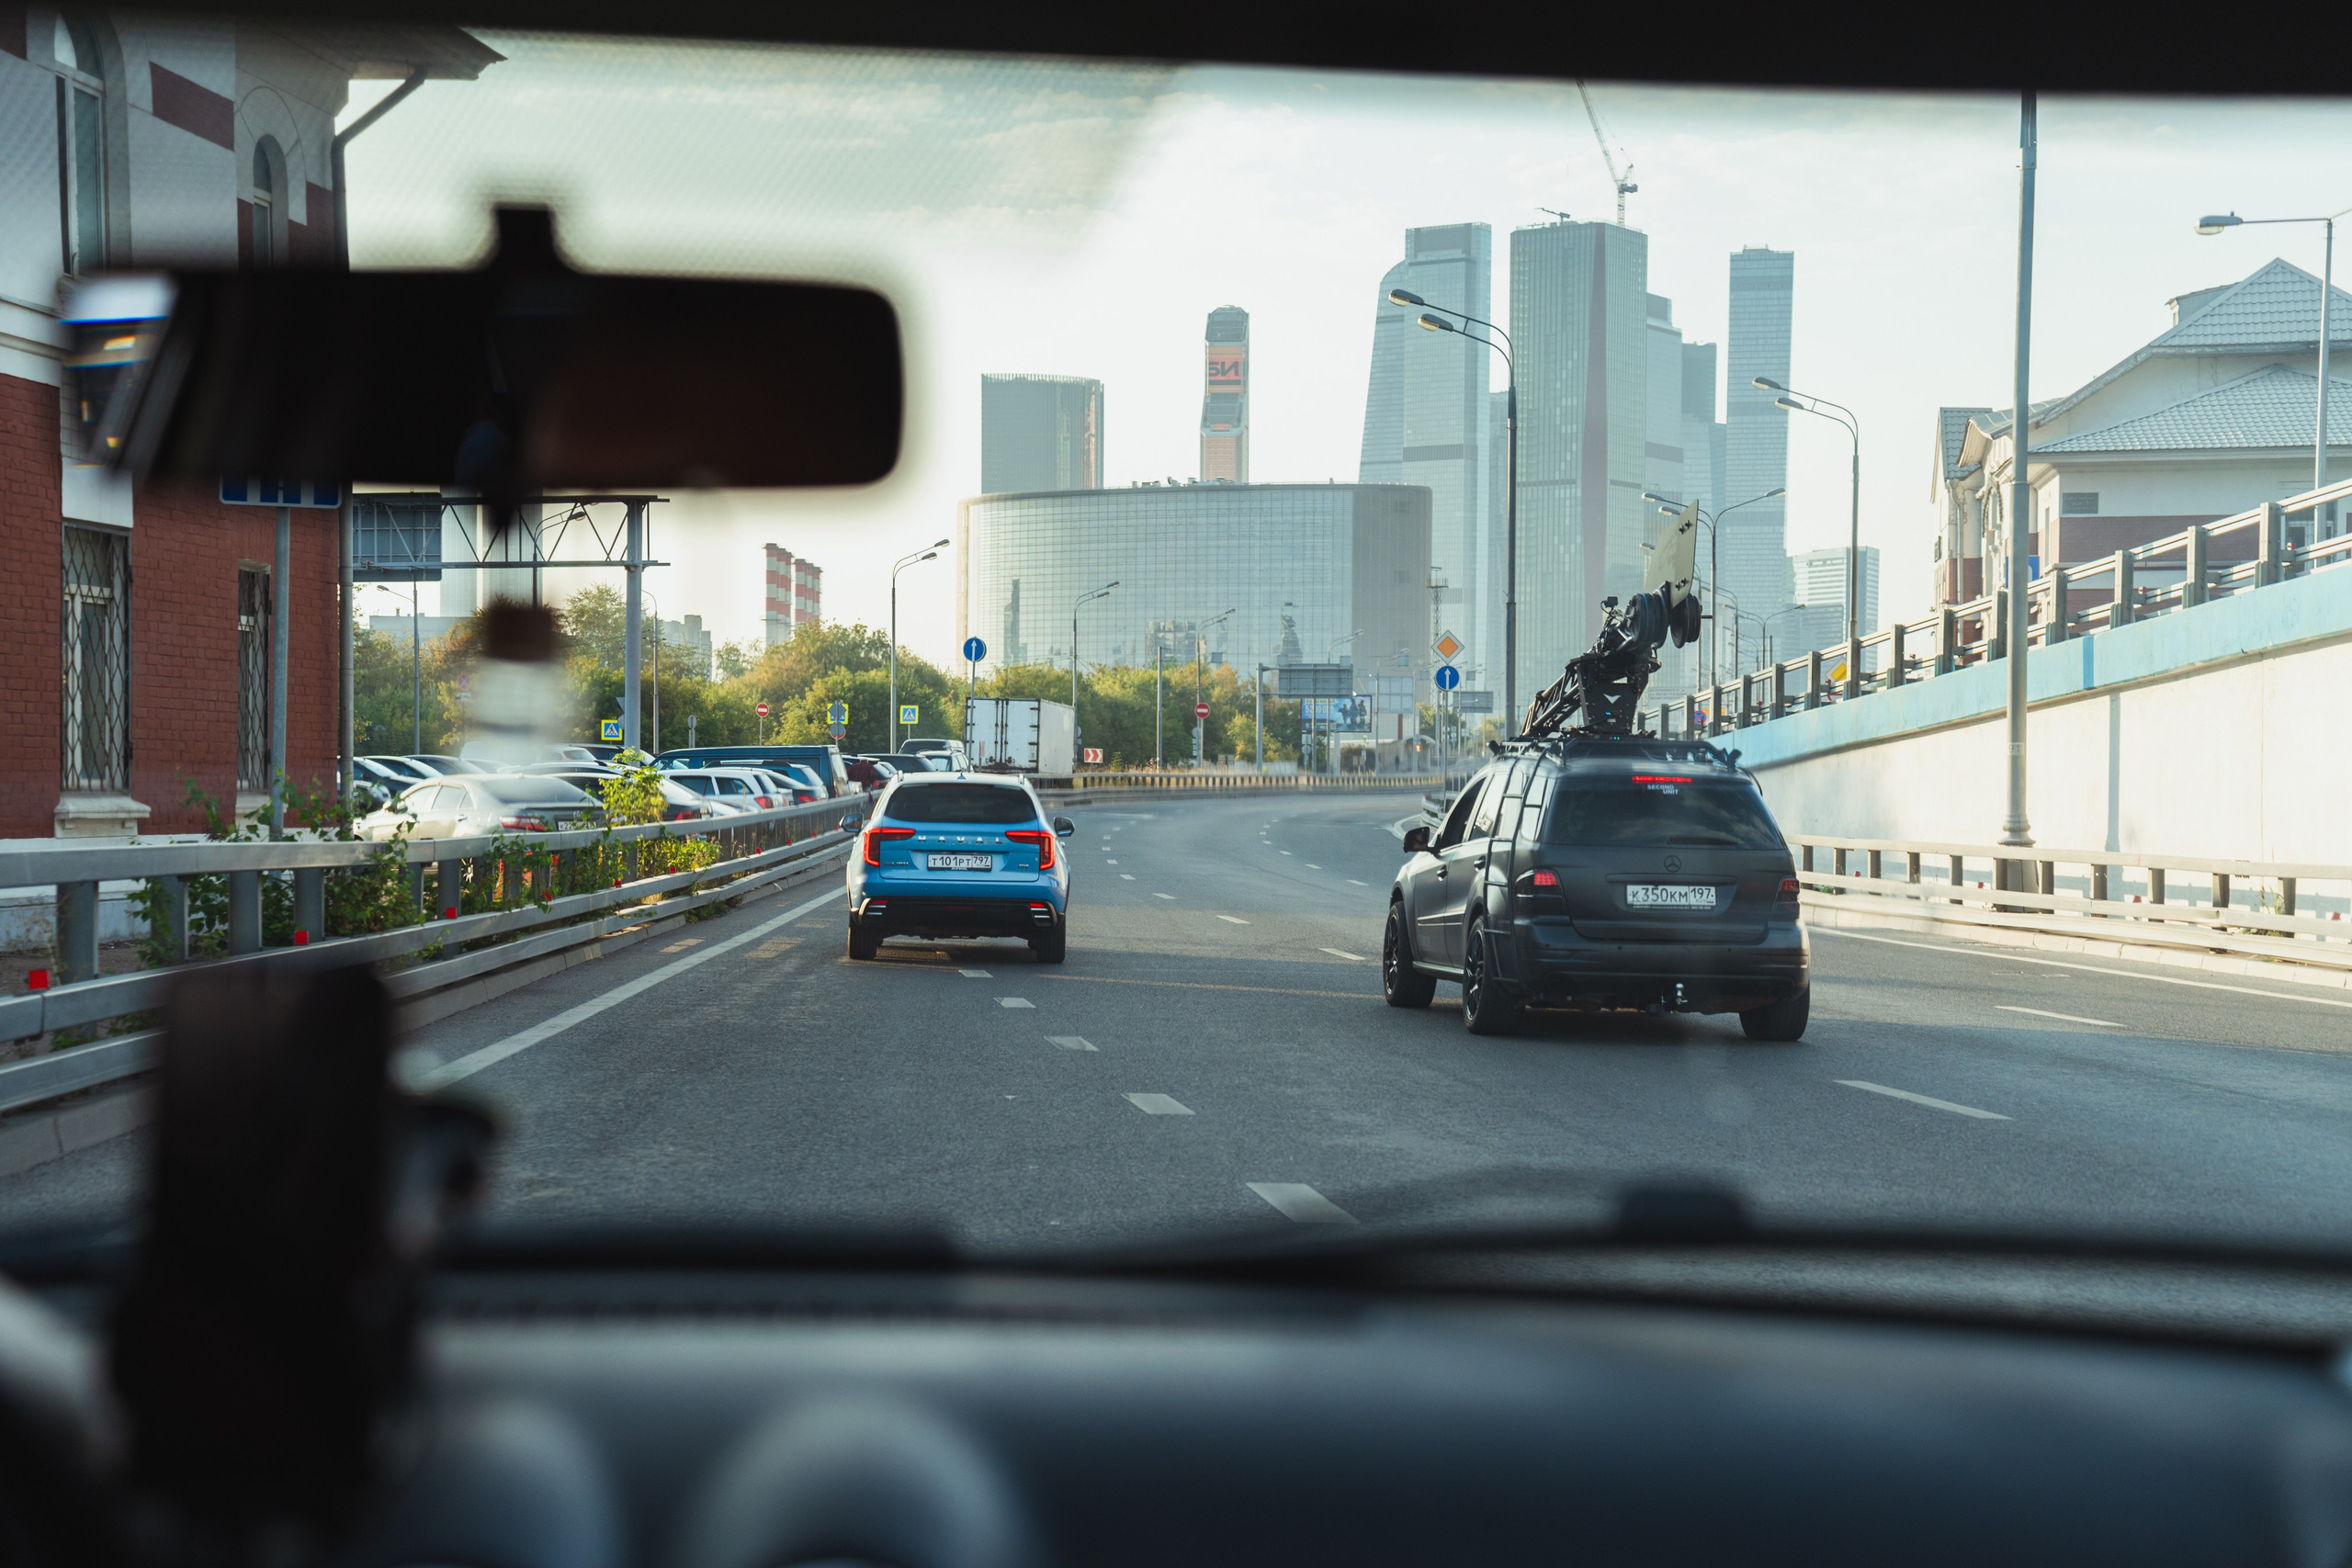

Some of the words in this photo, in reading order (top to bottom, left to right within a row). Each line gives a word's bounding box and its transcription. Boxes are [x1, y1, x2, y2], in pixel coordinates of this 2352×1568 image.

[918, 835, 1002, 844] HAVAL
[974, 856, 989, 864] 797
[1690, 887, 1712, 899] 197
